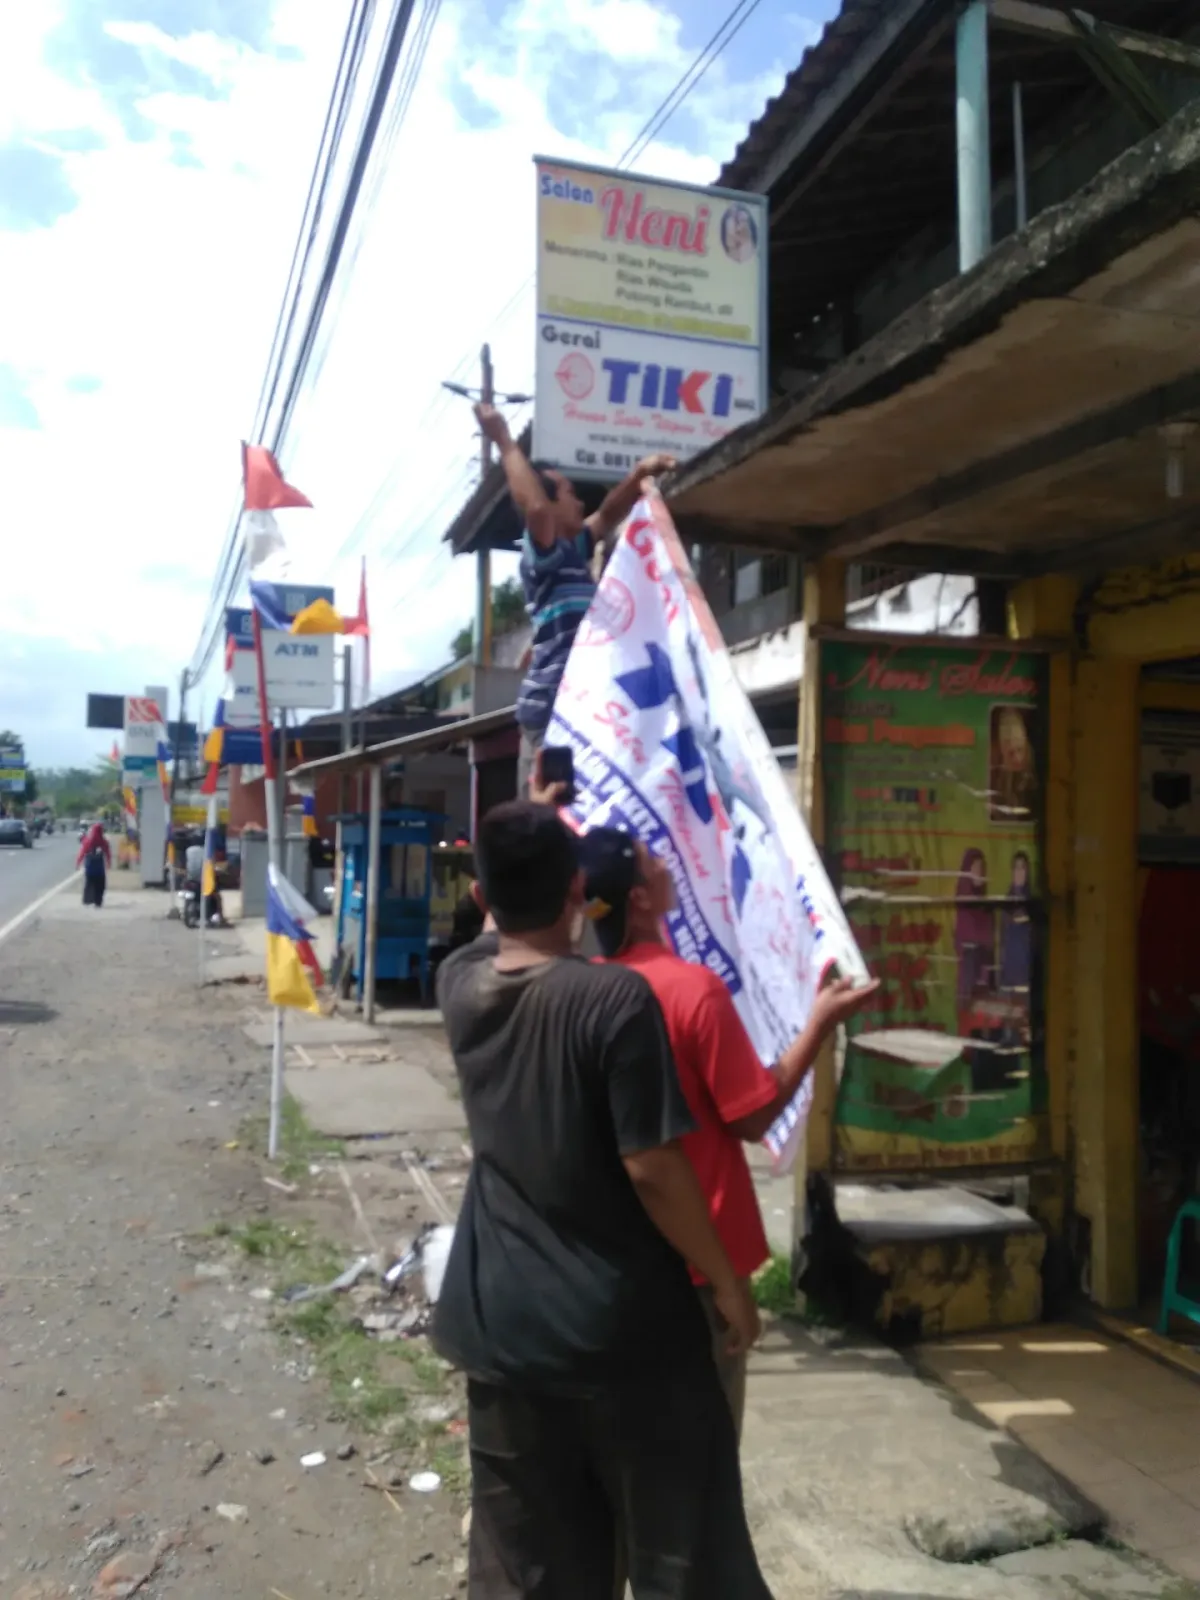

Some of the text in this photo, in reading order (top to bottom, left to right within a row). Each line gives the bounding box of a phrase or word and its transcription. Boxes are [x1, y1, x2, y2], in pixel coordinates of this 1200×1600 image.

[540, 173, 711, 256] Salon Neni
[541, 325, 601, 349] Gerai
[274, 642, 319, 656] ATM
